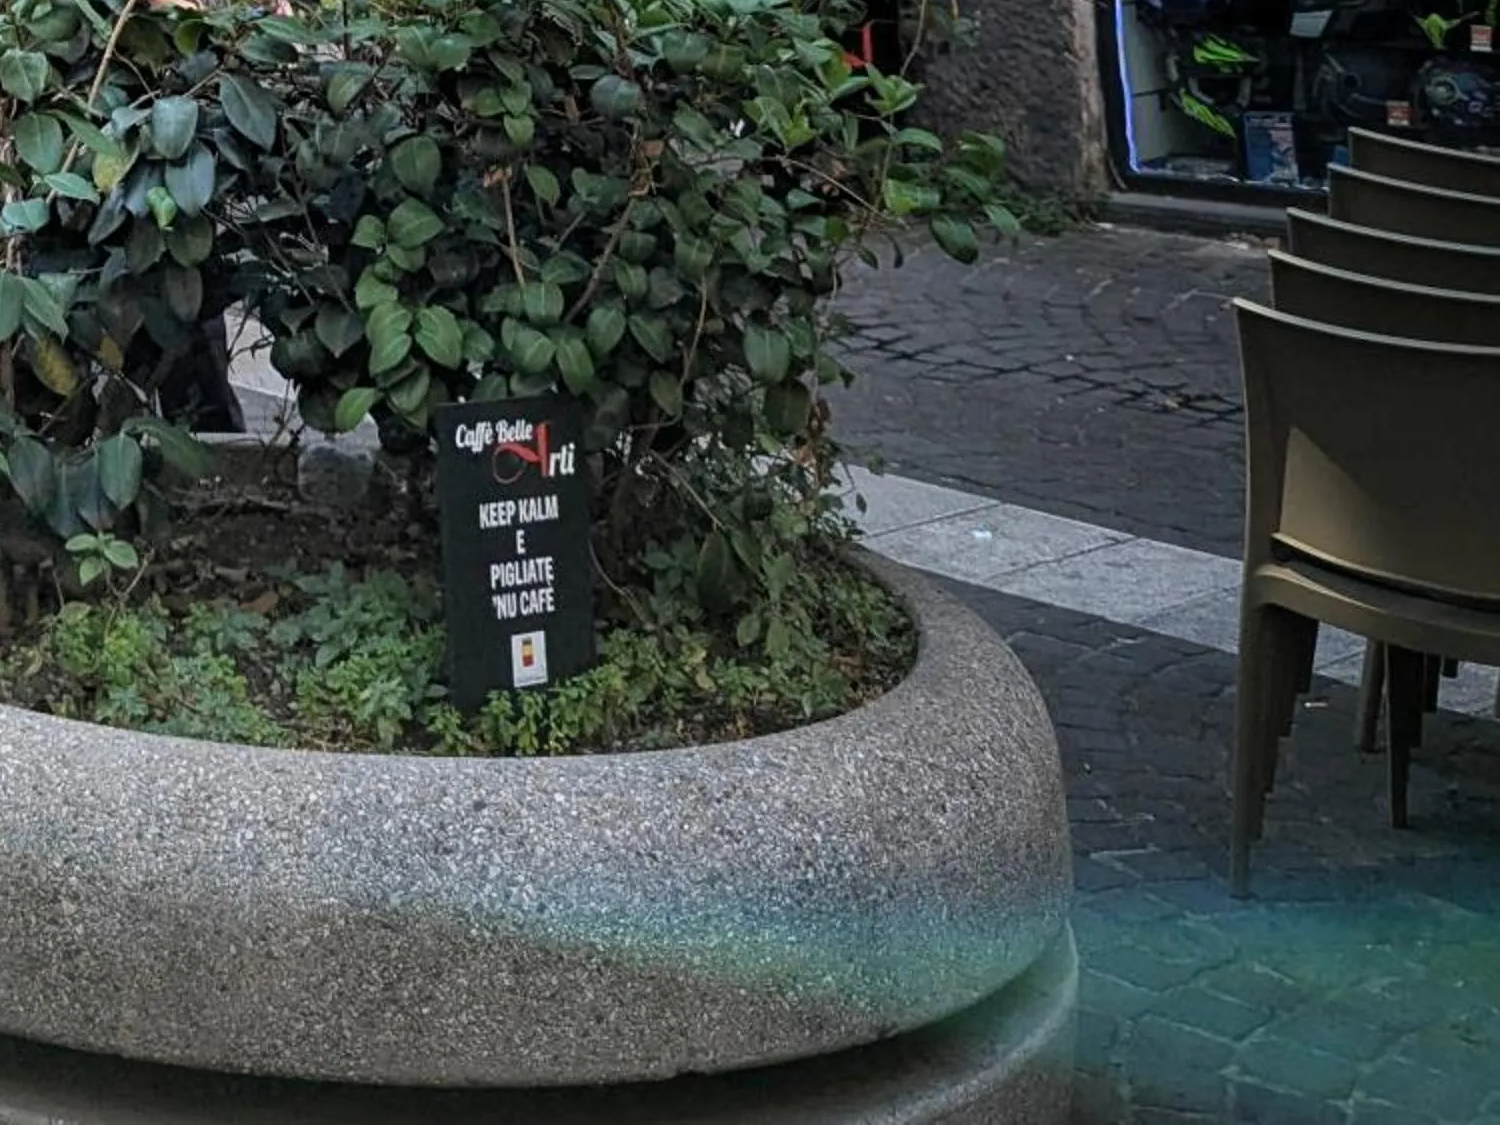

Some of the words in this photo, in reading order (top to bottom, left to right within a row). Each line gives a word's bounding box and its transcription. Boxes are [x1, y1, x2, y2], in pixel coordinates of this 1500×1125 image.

[455, 421, 493, 453] Caffè
[495, 419, 533, 443] Belle
[500, 422, 575, 482] Arti
[479, 500, 516, 529] KEEP
[518, 495, 558, 523] KALM
[516, 529, 525, 555] E
[490, 556, 554, 589] PIGLIATE
